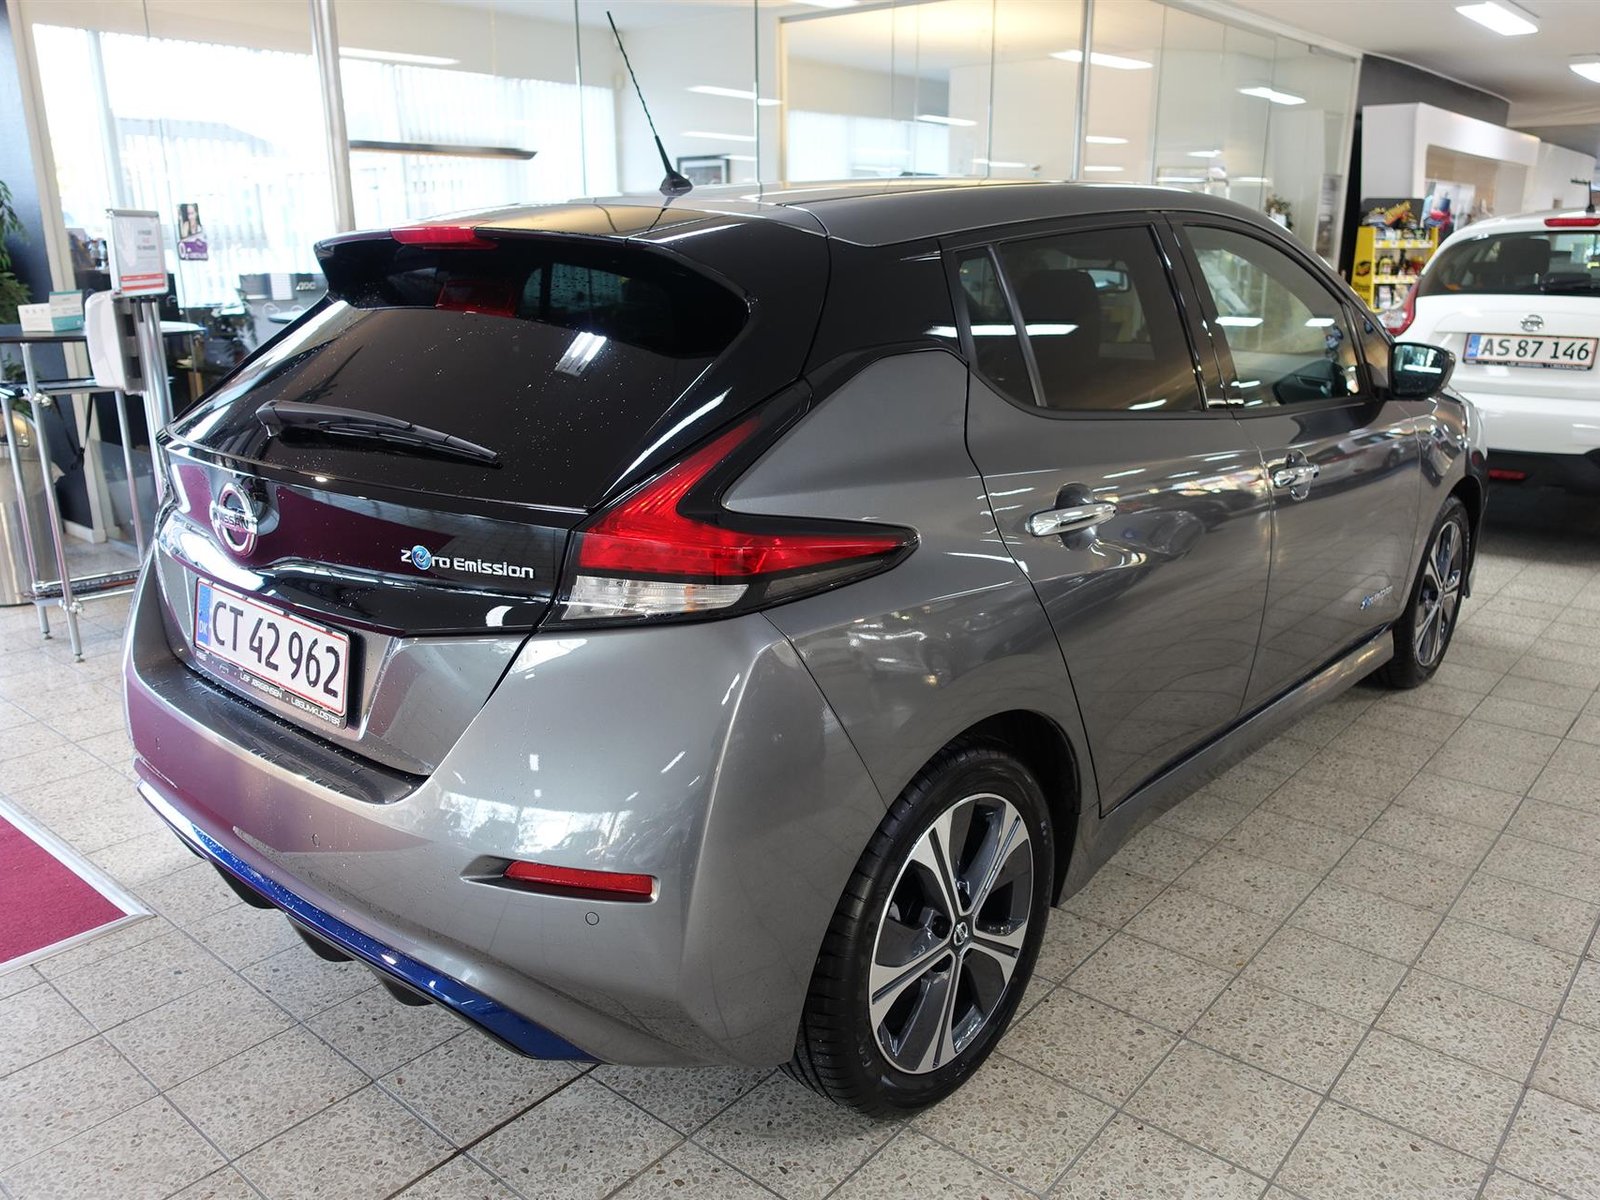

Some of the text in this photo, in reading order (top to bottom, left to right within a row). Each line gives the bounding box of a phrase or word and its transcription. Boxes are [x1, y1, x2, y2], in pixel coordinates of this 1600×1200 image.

[1481, 338, 1511, 357] AS
[1515, 340, 1543, 358] 87
[1550, 341, 1589, 361] 146
[453, 557, 534, 579] Emission
[198, 620, 208, 636] DK
[212, 600, 340, 698] CT 42 962
